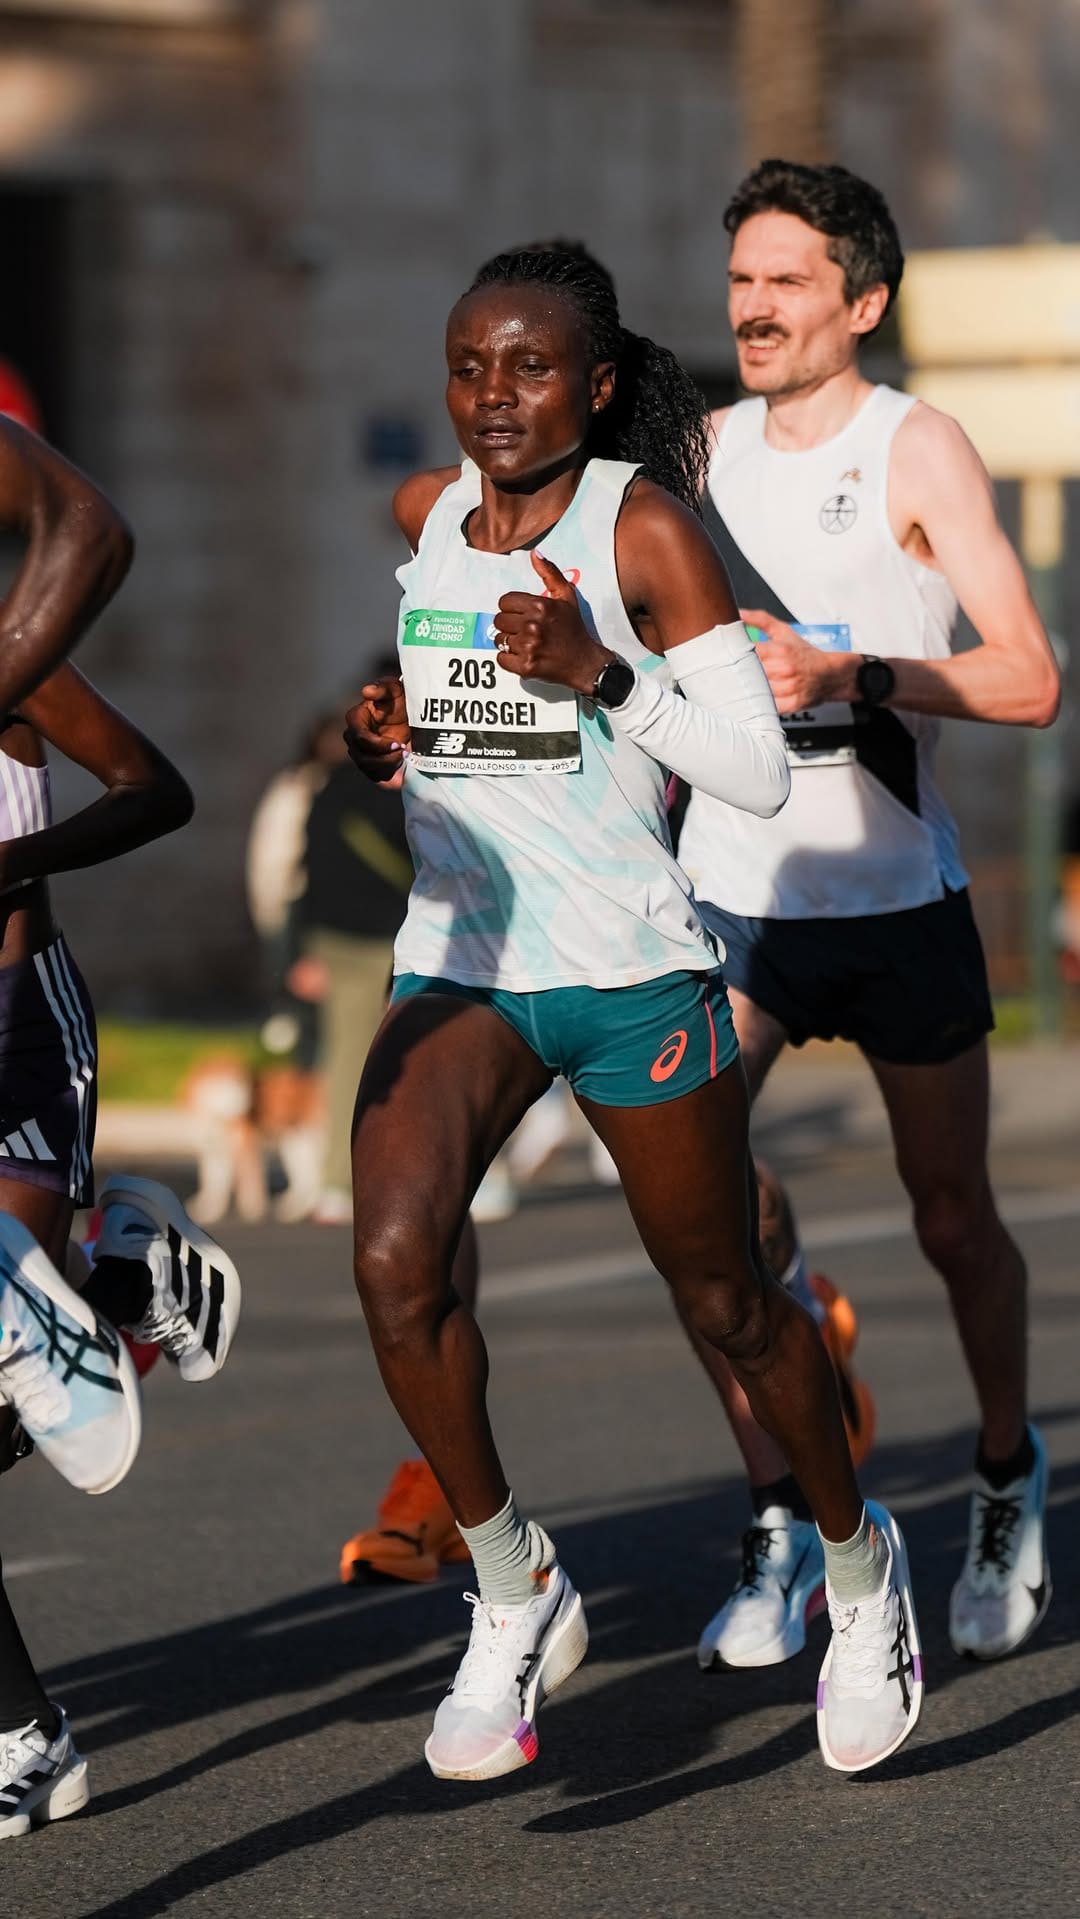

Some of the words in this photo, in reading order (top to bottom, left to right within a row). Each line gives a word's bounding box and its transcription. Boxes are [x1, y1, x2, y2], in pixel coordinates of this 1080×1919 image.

[431, 623, 466, 635] TRINIDAD
[429, 632, 464, 642] ALFONSO
[448, 658, 497, 690] 203
[420, 697, 537, 727] JEPKOSGEI
[467, 748, 483, 756] new
[483, 747, 517, 757] balance
[439, 761, 477, 771] TRINIDAD
[478, 762, 517, 772] ALFONSO
